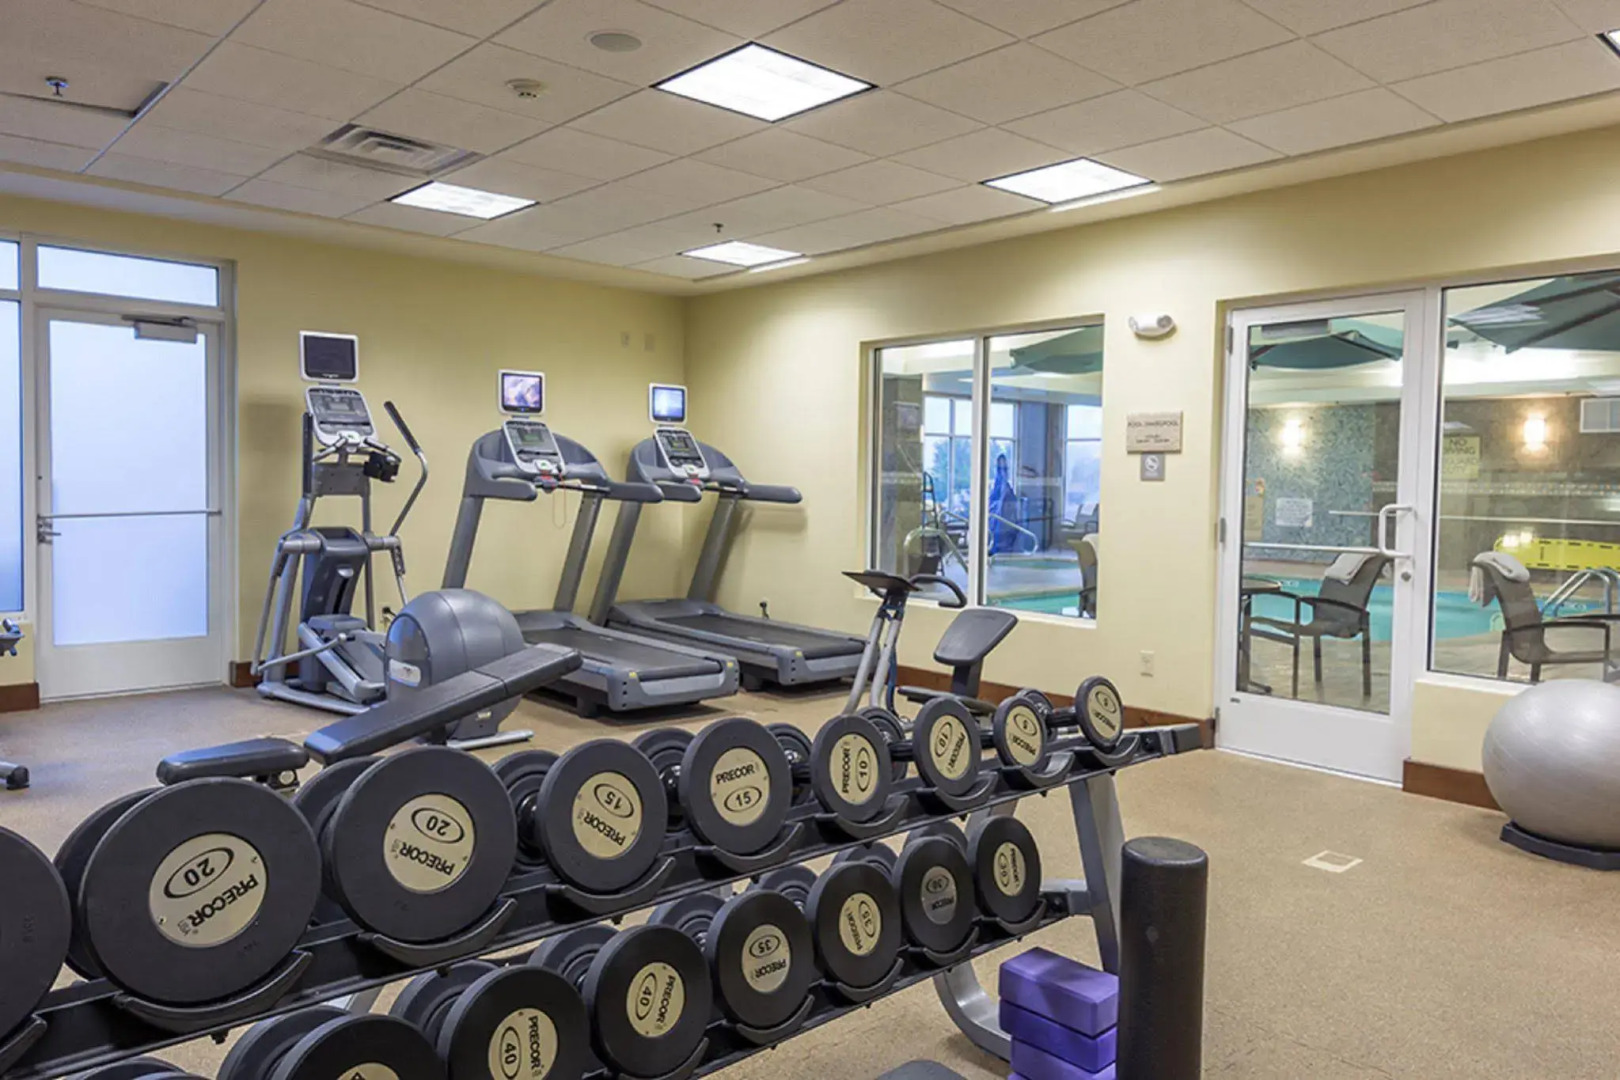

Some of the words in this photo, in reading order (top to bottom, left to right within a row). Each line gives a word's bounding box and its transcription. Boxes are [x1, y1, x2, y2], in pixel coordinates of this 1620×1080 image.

[938, 732, 949, 748] 10
[948, 731, 966, 768] PRECOR
[1012, 735, 1036, 755] PRECOR
[715, 763, 756, 785] PRECOR
[842, 748, 851, 794] PRECOR
[859, 760, 868, 778] 10
[604, 790, 623, 811] 15
[734, 791, 752, 807] 15
[426, 813, 452, 837] 20
[583, 810, 627, 846] PRECOR
[399, 841, 456, 877] PRECOR
[183, 856, 216, 887] 20
[186, 873, 260, 929] PRECOR
[862, 910, 872, 928] 35
[847, 911, 863, 951] PRECOR
[758, 939, 772, 954] 35
[754, 958, 787, 979] PRECOR
[639, 985, 652, 1007] 40
[656, 974, 677, 1024] PRECOR
[503, 1042, 518, 1065] 40
[527, 1014, 542, 1071] PRECOR
